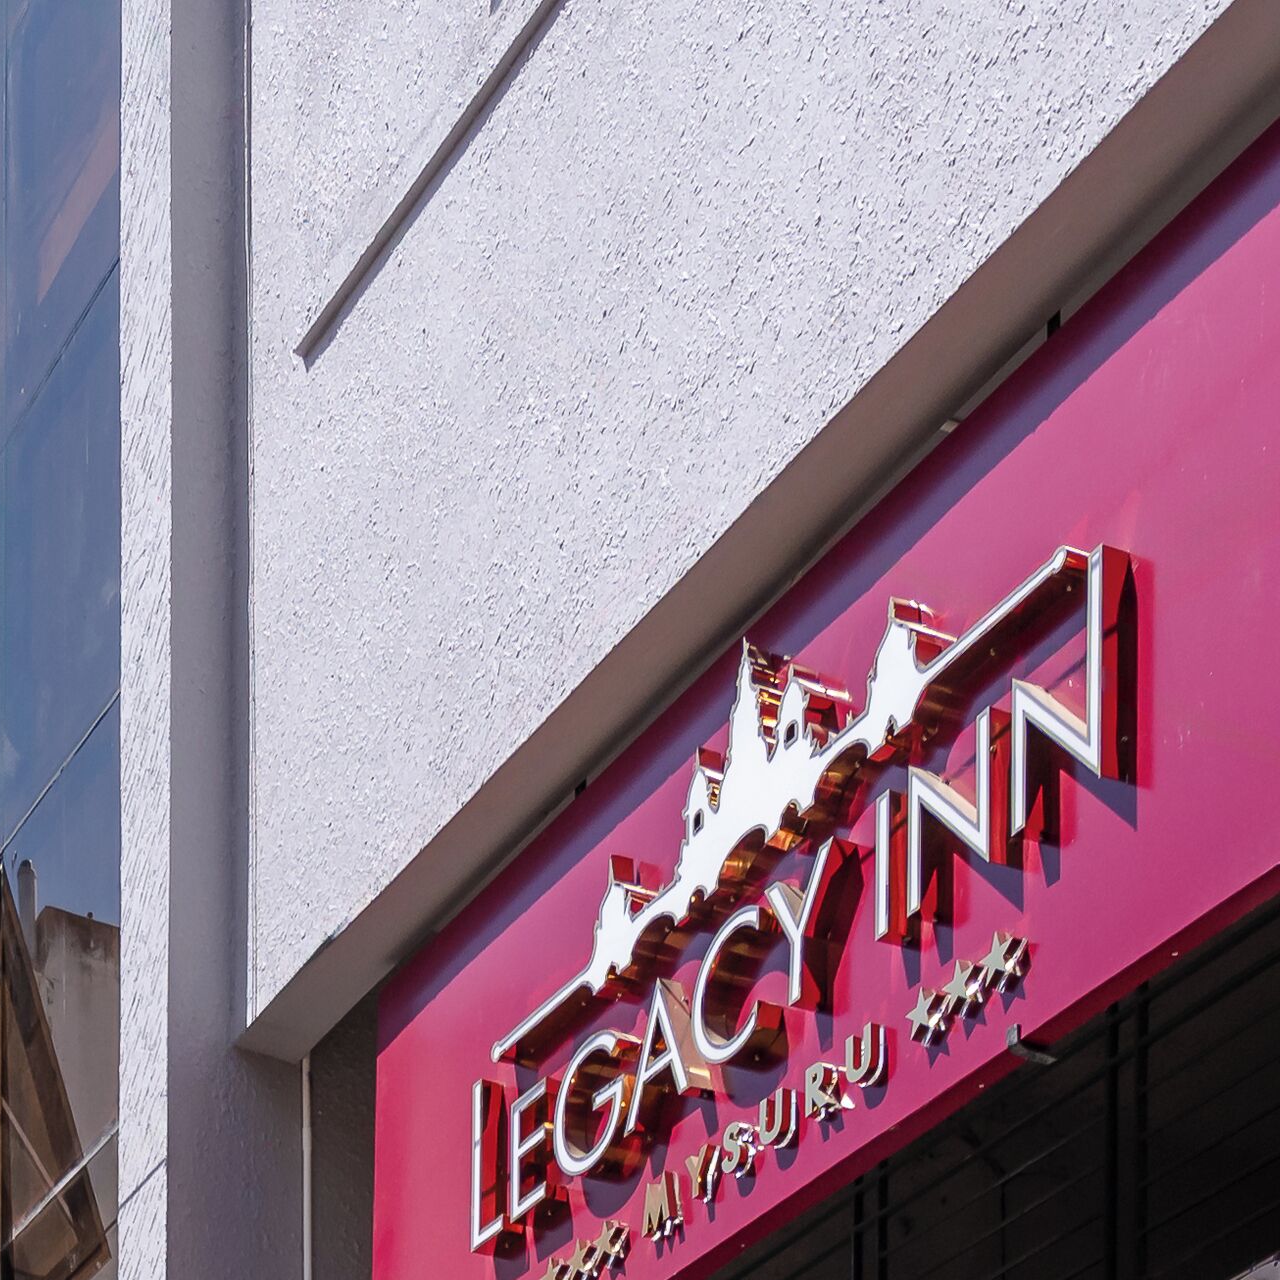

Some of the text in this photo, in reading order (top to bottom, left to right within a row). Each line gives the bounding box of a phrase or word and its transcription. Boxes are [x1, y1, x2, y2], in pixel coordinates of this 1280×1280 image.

[470, 542, 1105, 1253] LEGACY INN
[641, 1021, 886, 1242] MYSURU
